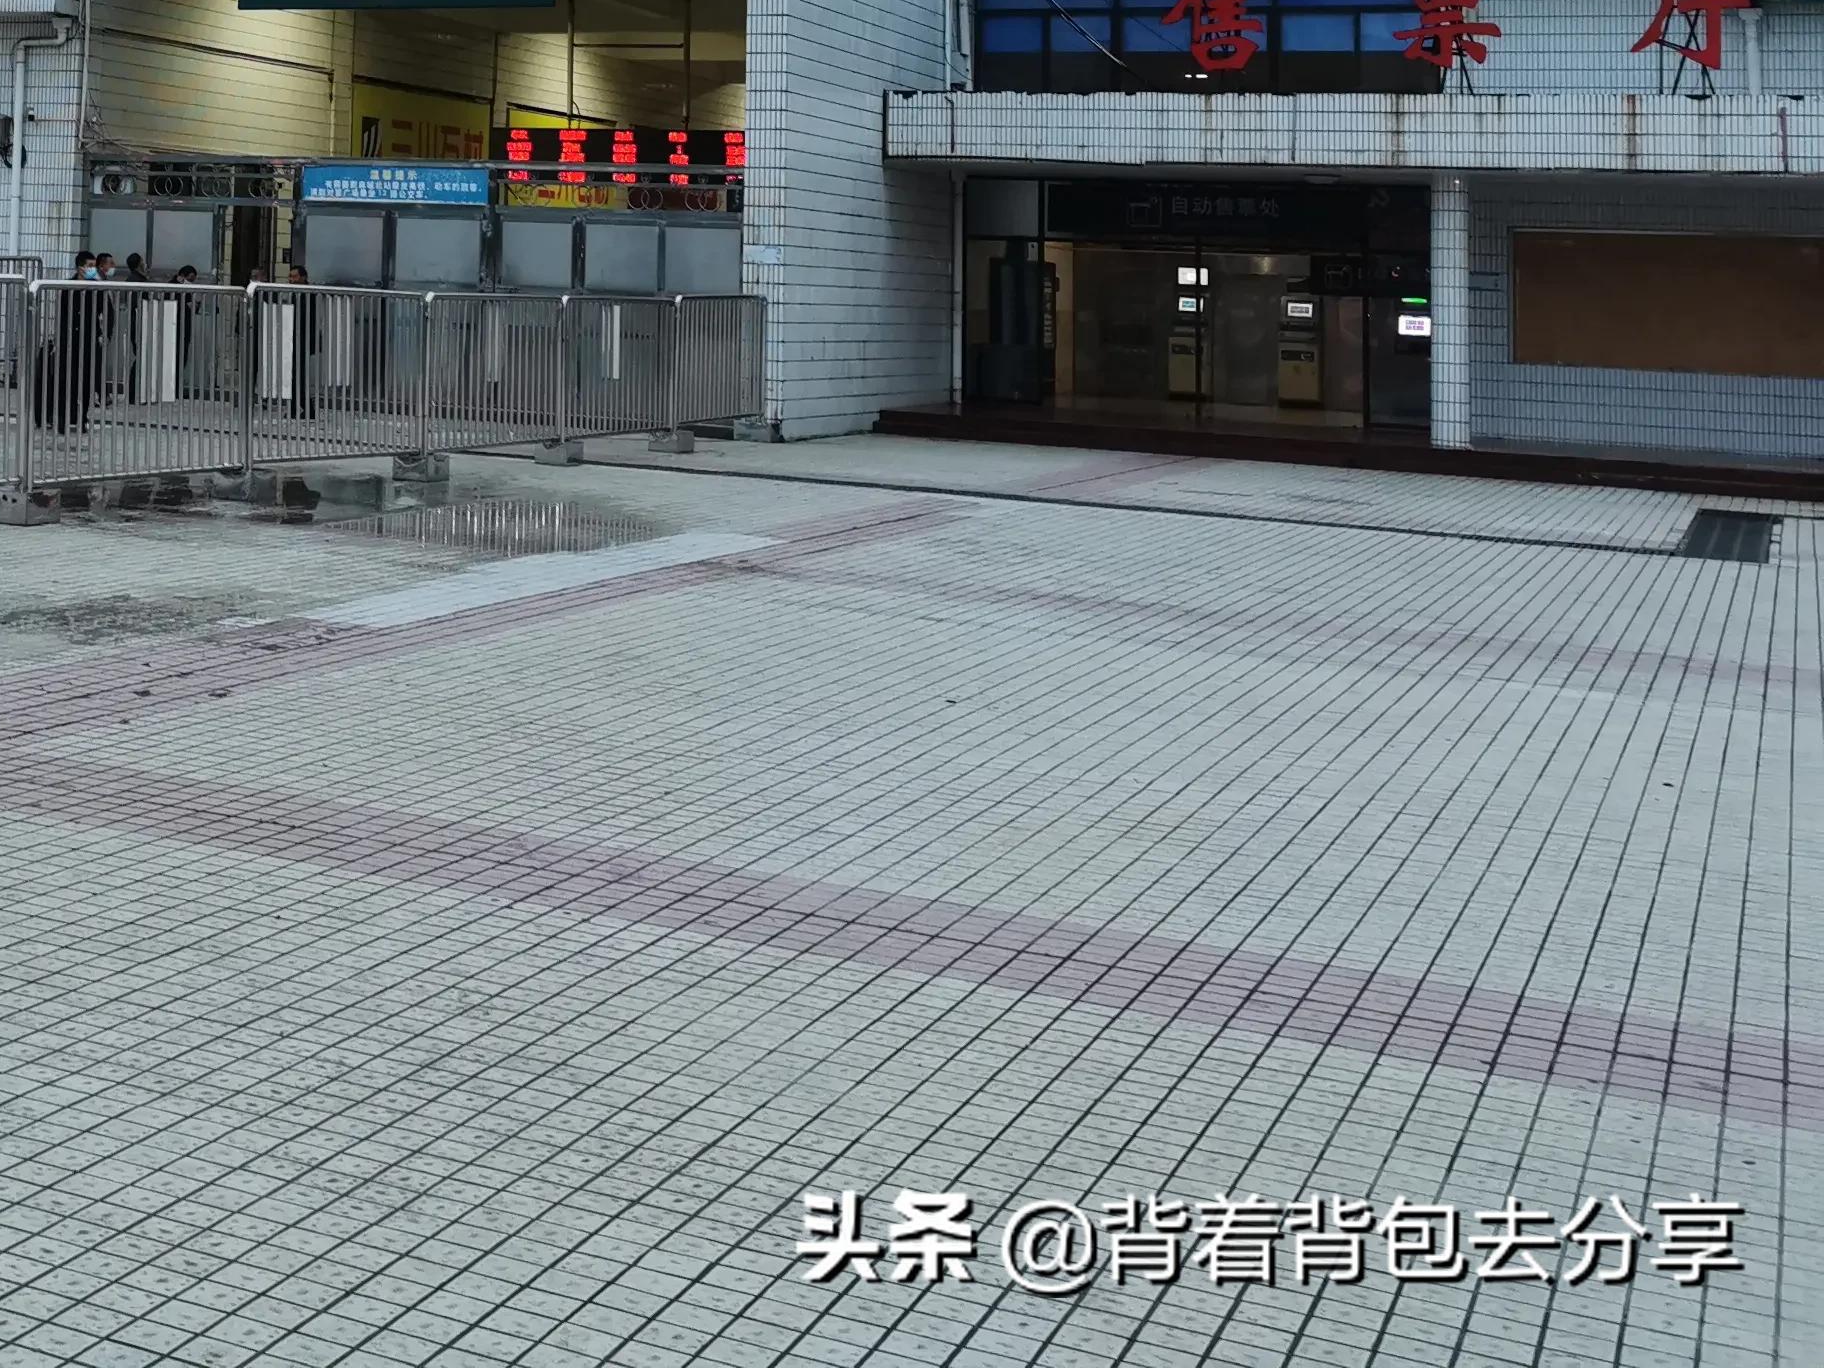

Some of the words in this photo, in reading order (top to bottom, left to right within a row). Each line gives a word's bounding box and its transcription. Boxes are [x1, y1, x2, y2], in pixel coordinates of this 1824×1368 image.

[1171, 195, 1280, 218] 自动售票处
